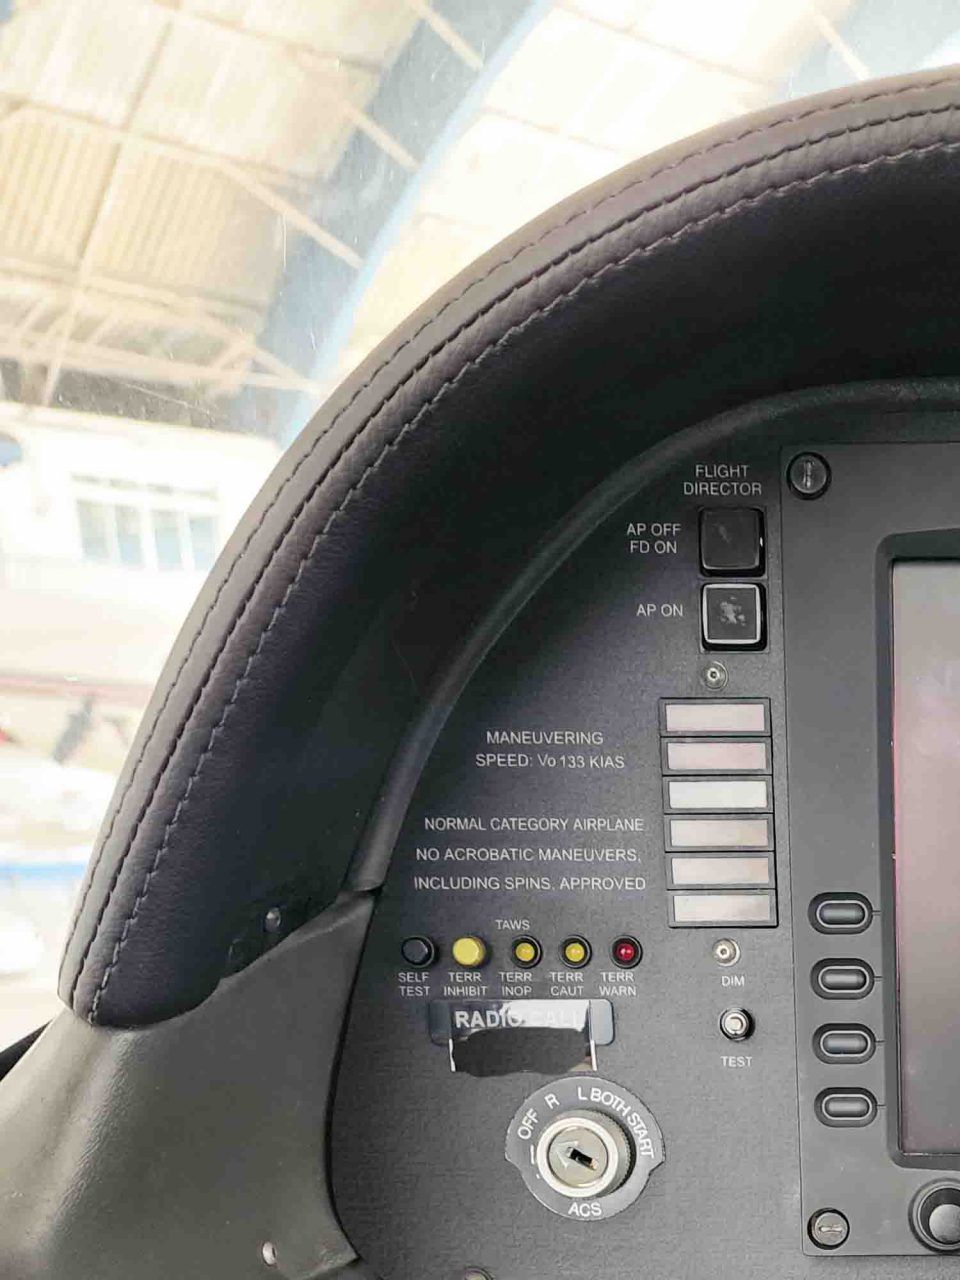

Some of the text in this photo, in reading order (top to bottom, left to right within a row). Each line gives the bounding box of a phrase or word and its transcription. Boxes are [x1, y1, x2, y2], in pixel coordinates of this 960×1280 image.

[695, 464, 749, 477] FLIGHT
[683, 482, 762, 496] DIRECTOR
[626, 523, 681, 536] AP OFF
[630, 540, 677, 554] FD ON
[636, 604, 683, 617] AP ON
[486, 731, 604, 746] MANEUVERING
[475, 753, 533, 768] SPEED:
[559, 755, 586, 769] 133
[589, 755, 625, 769] KIAS
[424, 818, 645, 832] NORMAL CATEGORY AIRPLANE
[416, 848, 440, 862] NO
[445, 848, 534, 862] ACROBATIC
[414, 876, 500, 891] INCLUDING
[559, 877, 646, 891] APPROVED
[495, 919, 530, 930] TAWS
[398, 972, 429, 983] SELF
[448, 972, 481, 983] TERR
[499, 972, 532, 983] TERR
[549, 972, 584, 983] TERR
[601, 972, 634, 983] TERR
[721, 975, 745, 987] DIM
[400, 986, 430, 997] TEST
[443, 986, 488, 997] INHIBIT
[501, 986, 532, 997] INOP
[550, 986, 584, 997] CAUT
[599, 986, 637, 997] WARN
[720, 1056, 752, 1068] TEST
[577, 1086, 587, 1100] L
[544, 1093, 560, 1109] R
[590, 1087, 631, 1117] BOTH
[517, 1108, 539, 1140] OFF
[627, 1112, 655, 1159] START
[568, 1201, 602, 1218] ACS
